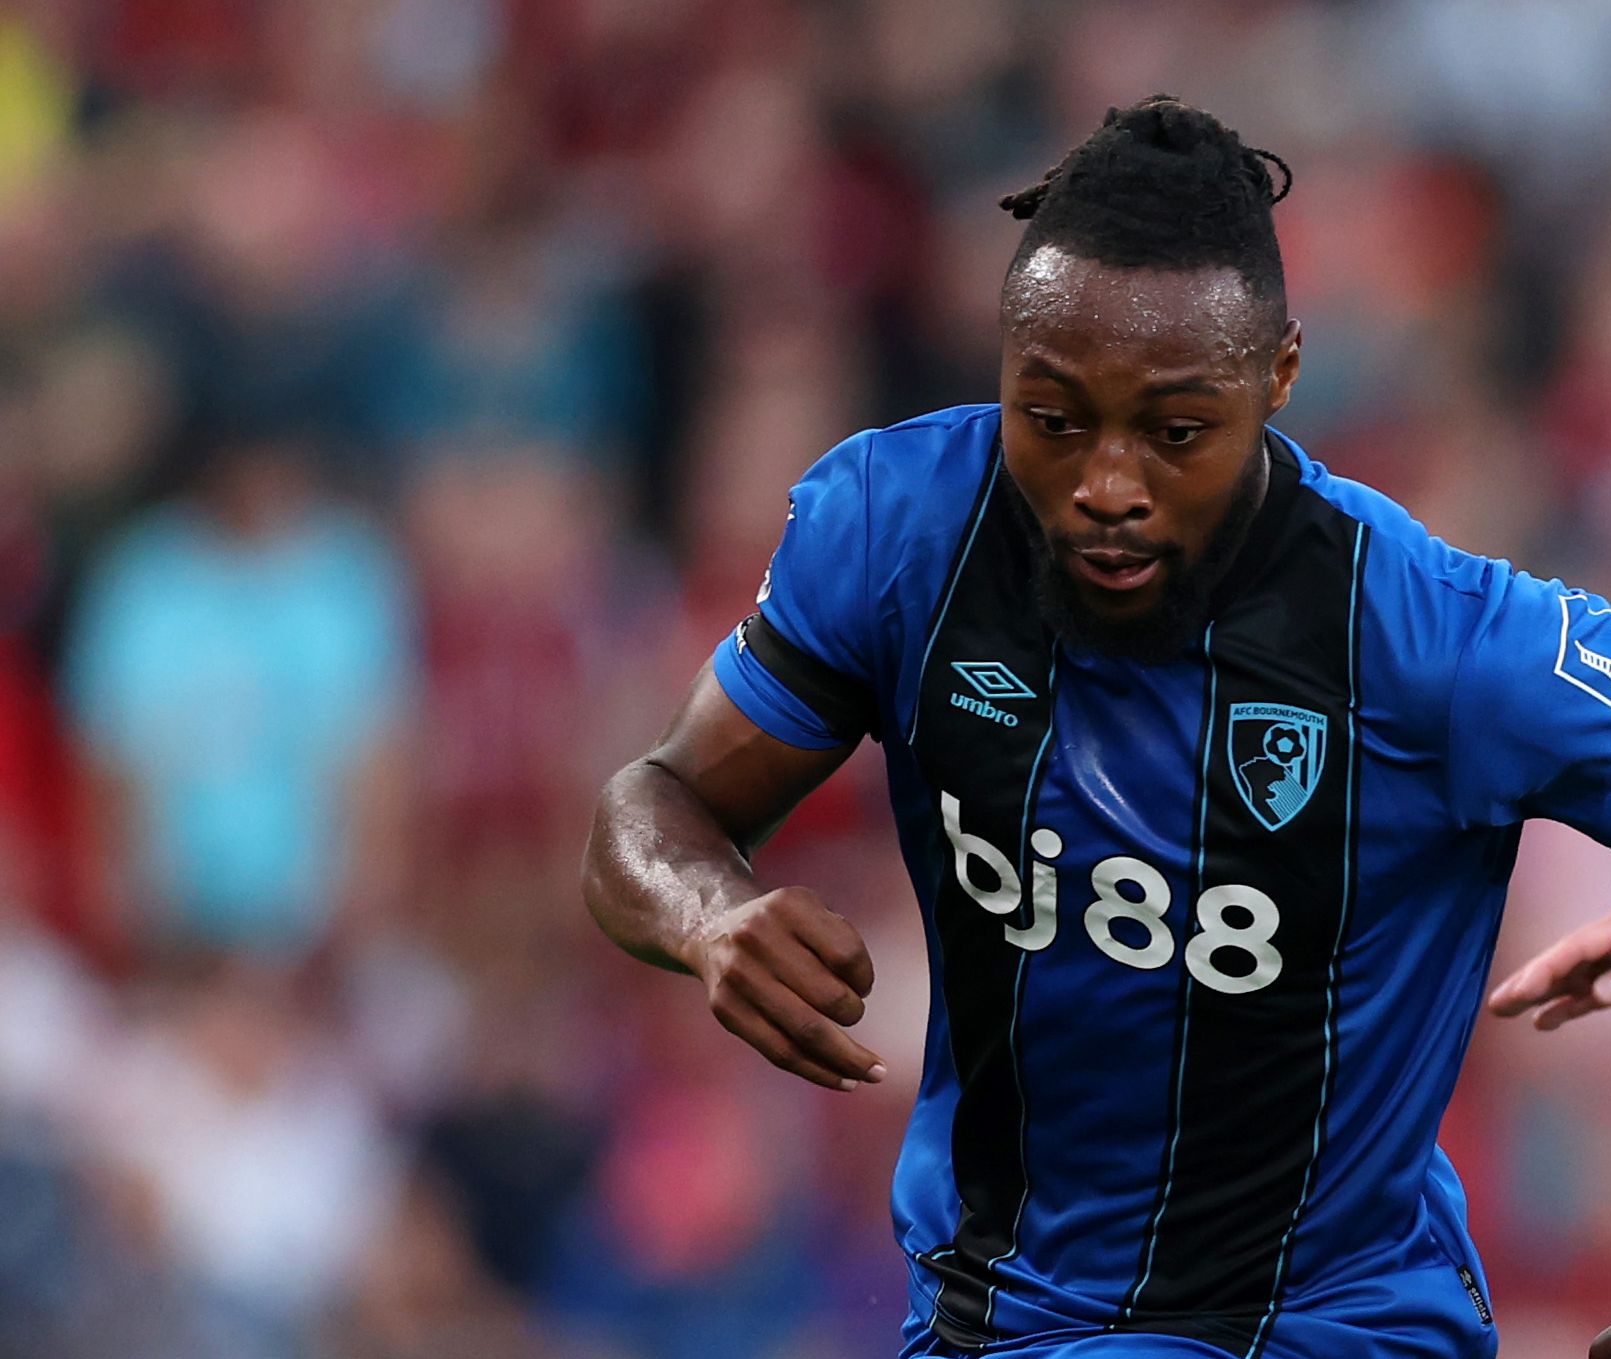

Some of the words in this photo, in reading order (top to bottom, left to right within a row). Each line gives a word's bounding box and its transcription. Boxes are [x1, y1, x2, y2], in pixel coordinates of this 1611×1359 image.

[950, 692, 1018, 727] umbro
[1233, 706, 1252, 716] AFC
[1253, 706, 1325, 726] BOURNEMOUTH
[941, 789, 1283, 994] bj88
